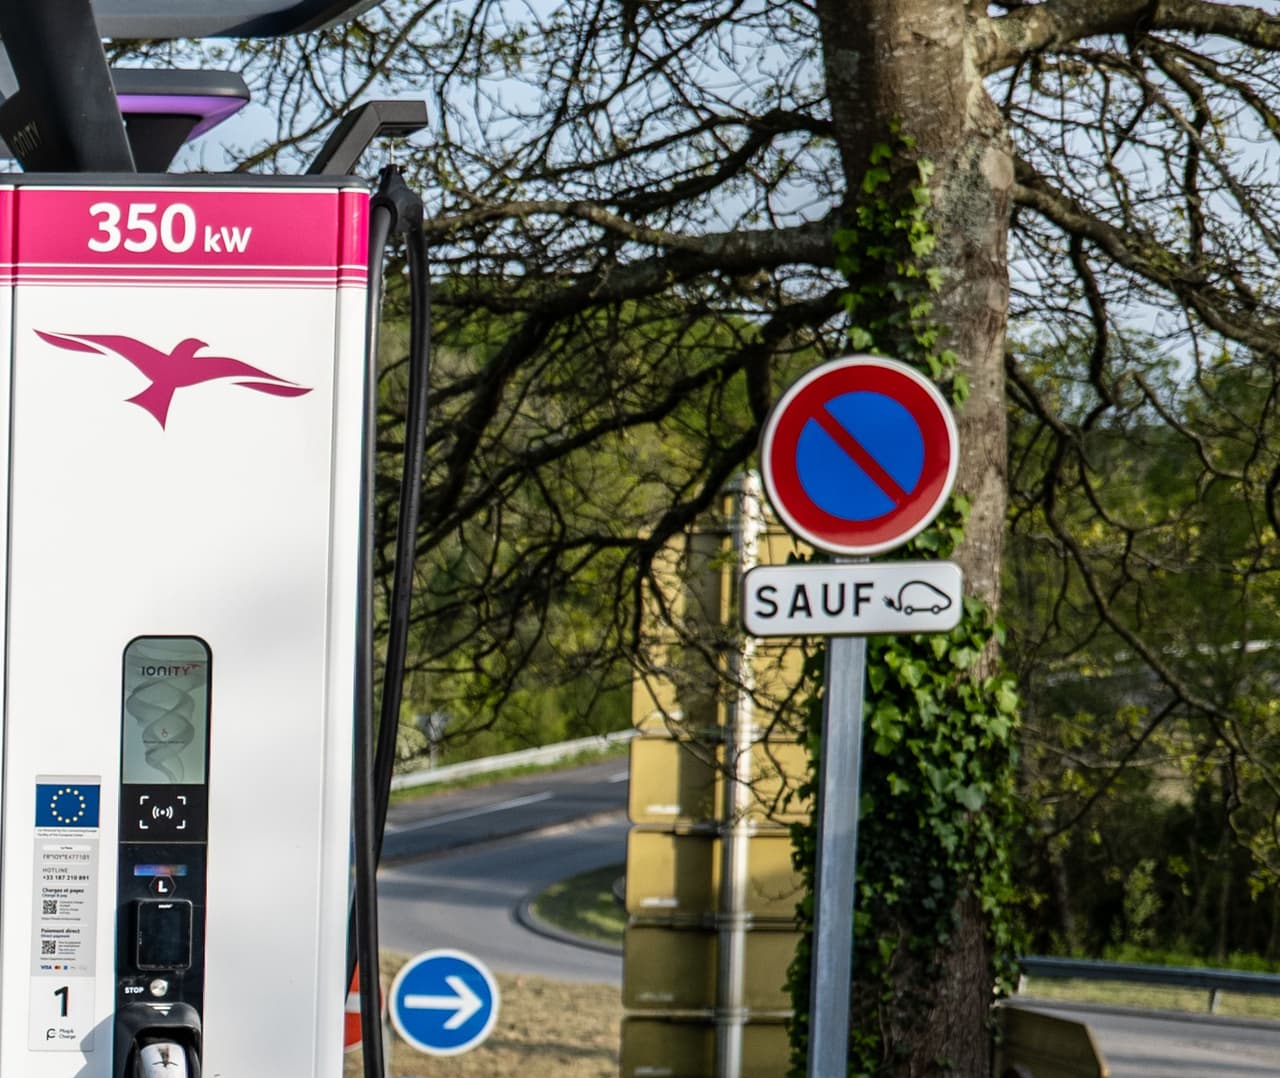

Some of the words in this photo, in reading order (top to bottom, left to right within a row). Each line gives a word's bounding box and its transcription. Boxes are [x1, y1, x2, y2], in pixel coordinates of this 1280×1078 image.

[87, 202, 197, 253] 350
[204, 225, 252, 253] kW
[755, 582, 874, 619] SAUF
[142, 665, 192, 677] IONITY
[157, 881, 168, 893] L
[124, 986, 144, 995] STOP
[54, 986, 69, 1017] 1
